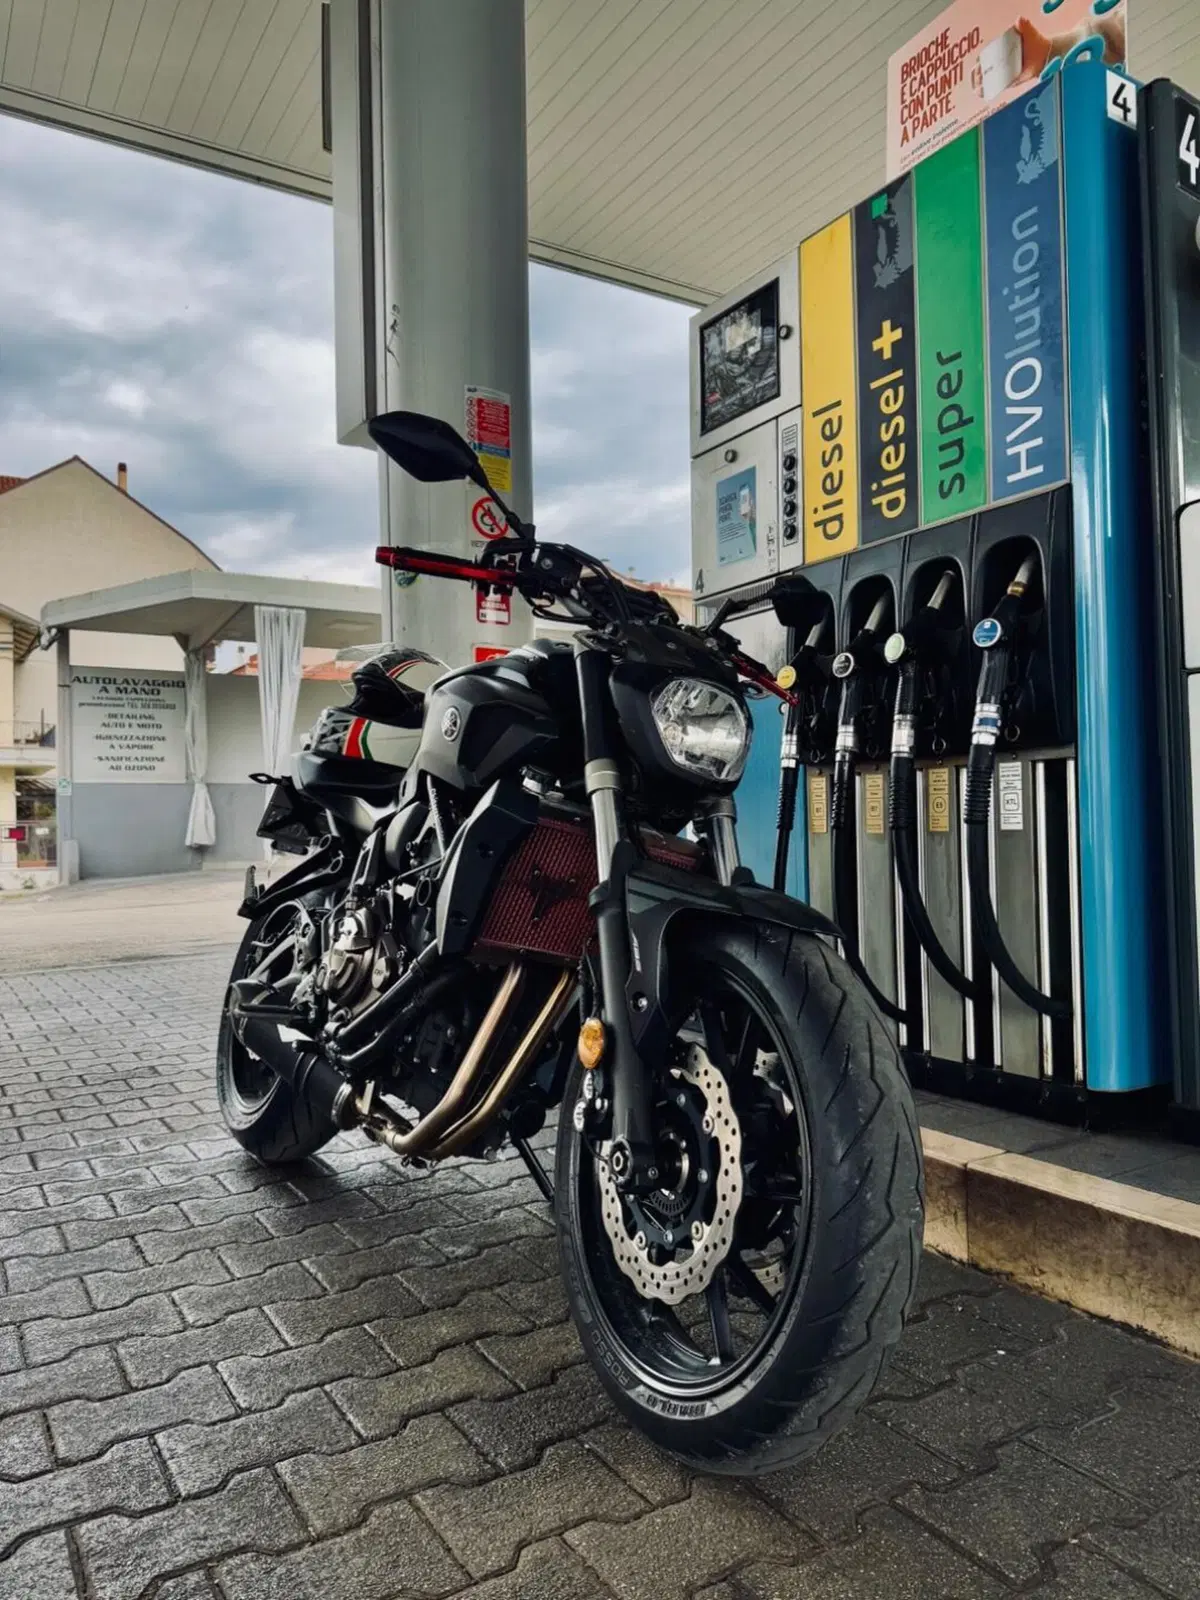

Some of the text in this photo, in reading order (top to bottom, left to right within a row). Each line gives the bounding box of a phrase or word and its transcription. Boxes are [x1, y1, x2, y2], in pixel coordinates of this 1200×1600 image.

[900, 26, 983, 105] E CAPPUCCIO.
[901, 27, 950, 85] BRIOCHE
[900, 60, 963, 125] CON PUNTI
[900, 125, 910, 147] A
[912, 91, 956, 138] PARTE.
[1112, 82, 1132, 122] 4
[1178, 113, 1200, 185] 4
[1002, 205, 1044, 484] HVOlution
[869, 368, 906, 519] diesel
[936, 350, 974, 500] super
[812, 398, 844, 542] diesel
[695, 568, 704, 593] 4
[71, 675, 186, 689] AUTOLAVAGGIO
[99, 685, 161, 696] A MANO
[137, 722, 162, 730] MOTO
[591, 1329, 631, 1388] ROSSO
